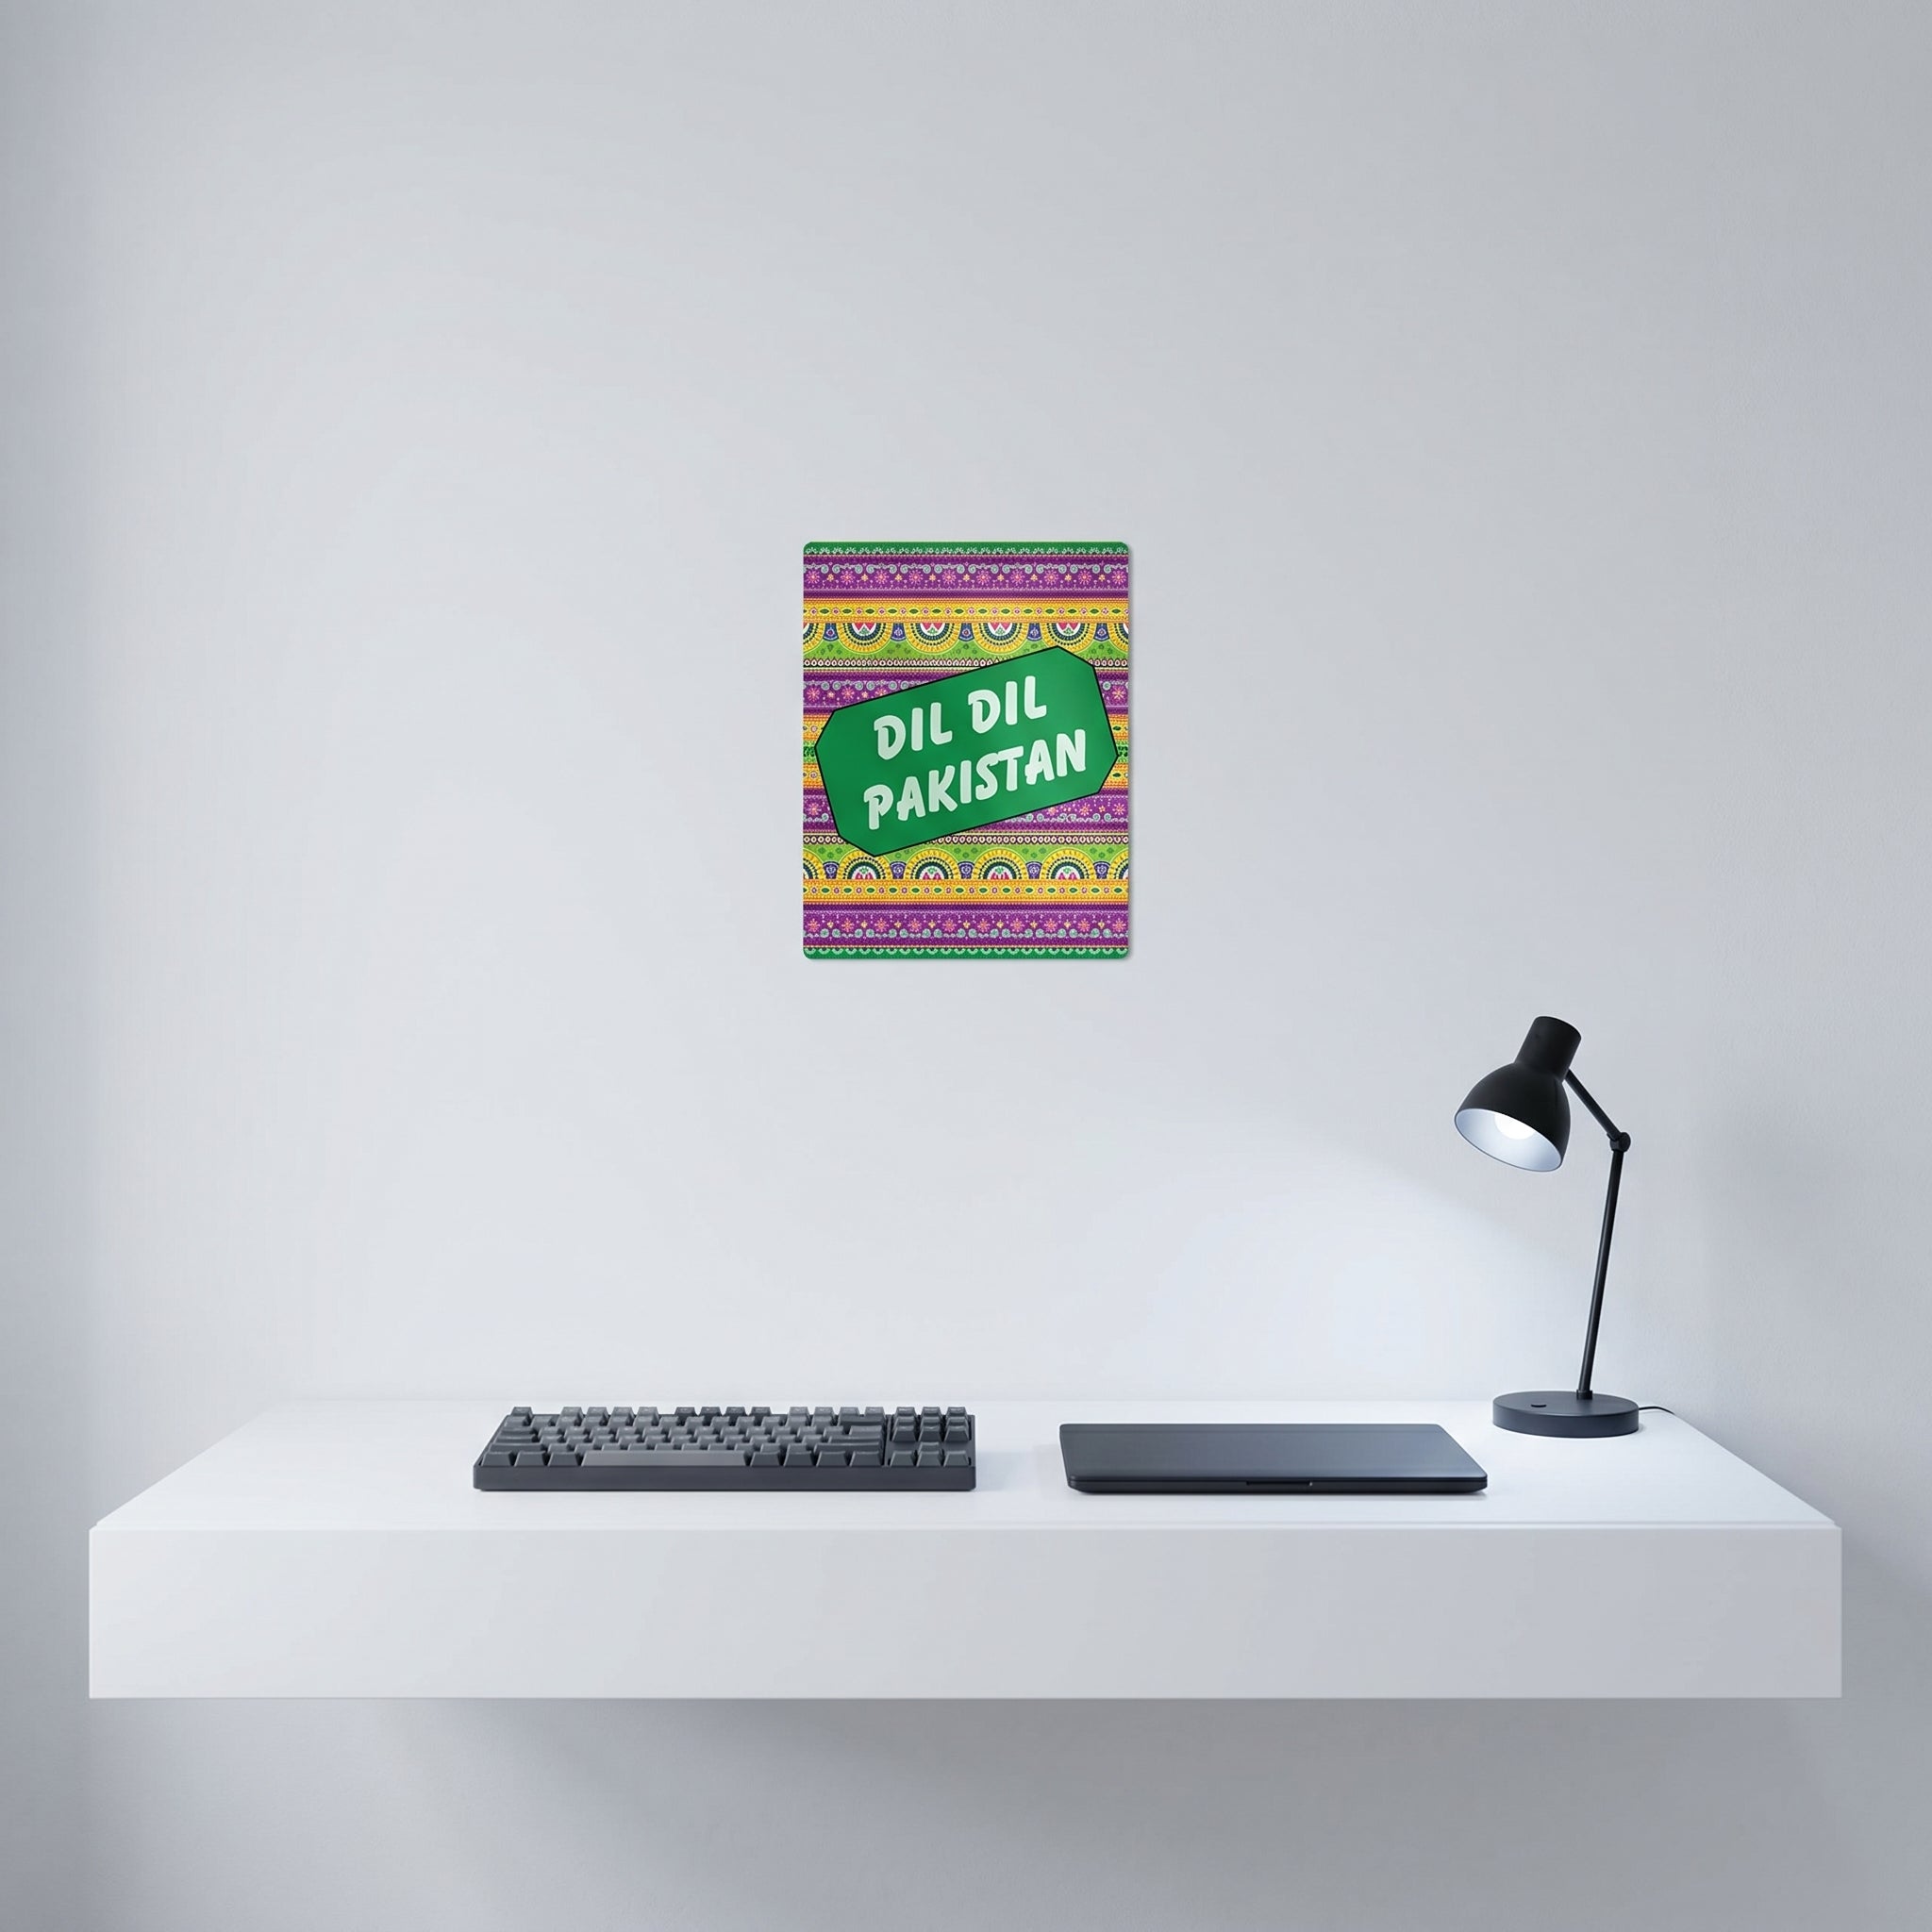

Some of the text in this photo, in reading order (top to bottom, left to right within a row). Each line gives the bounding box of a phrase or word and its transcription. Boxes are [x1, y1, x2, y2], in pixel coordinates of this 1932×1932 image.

[874, 675, 1047, 760] DIL DIL
[863, 728, 1087, 830] PAKISTAN
